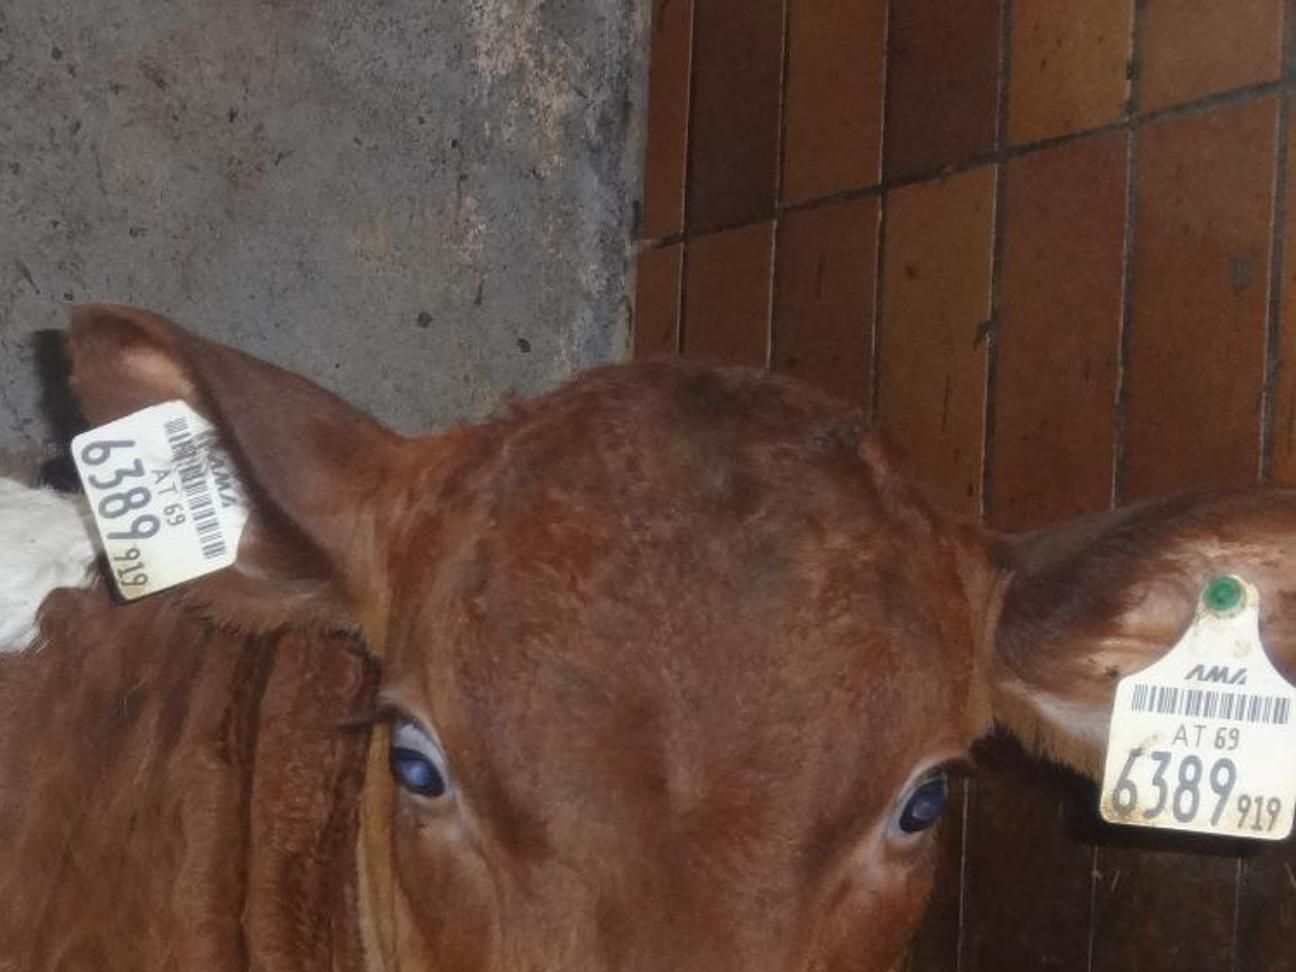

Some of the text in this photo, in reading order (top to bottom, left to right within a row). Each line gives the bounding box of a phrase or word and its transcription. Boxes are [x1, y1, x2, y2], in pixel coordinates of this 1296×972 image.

[81, 439, 161, 587] 6389 919
[151, 469, 186, 527] AT 69
[1172, 724, 1241, 751] AT 69
[1112, 748, 1283, 832] 6389 919
